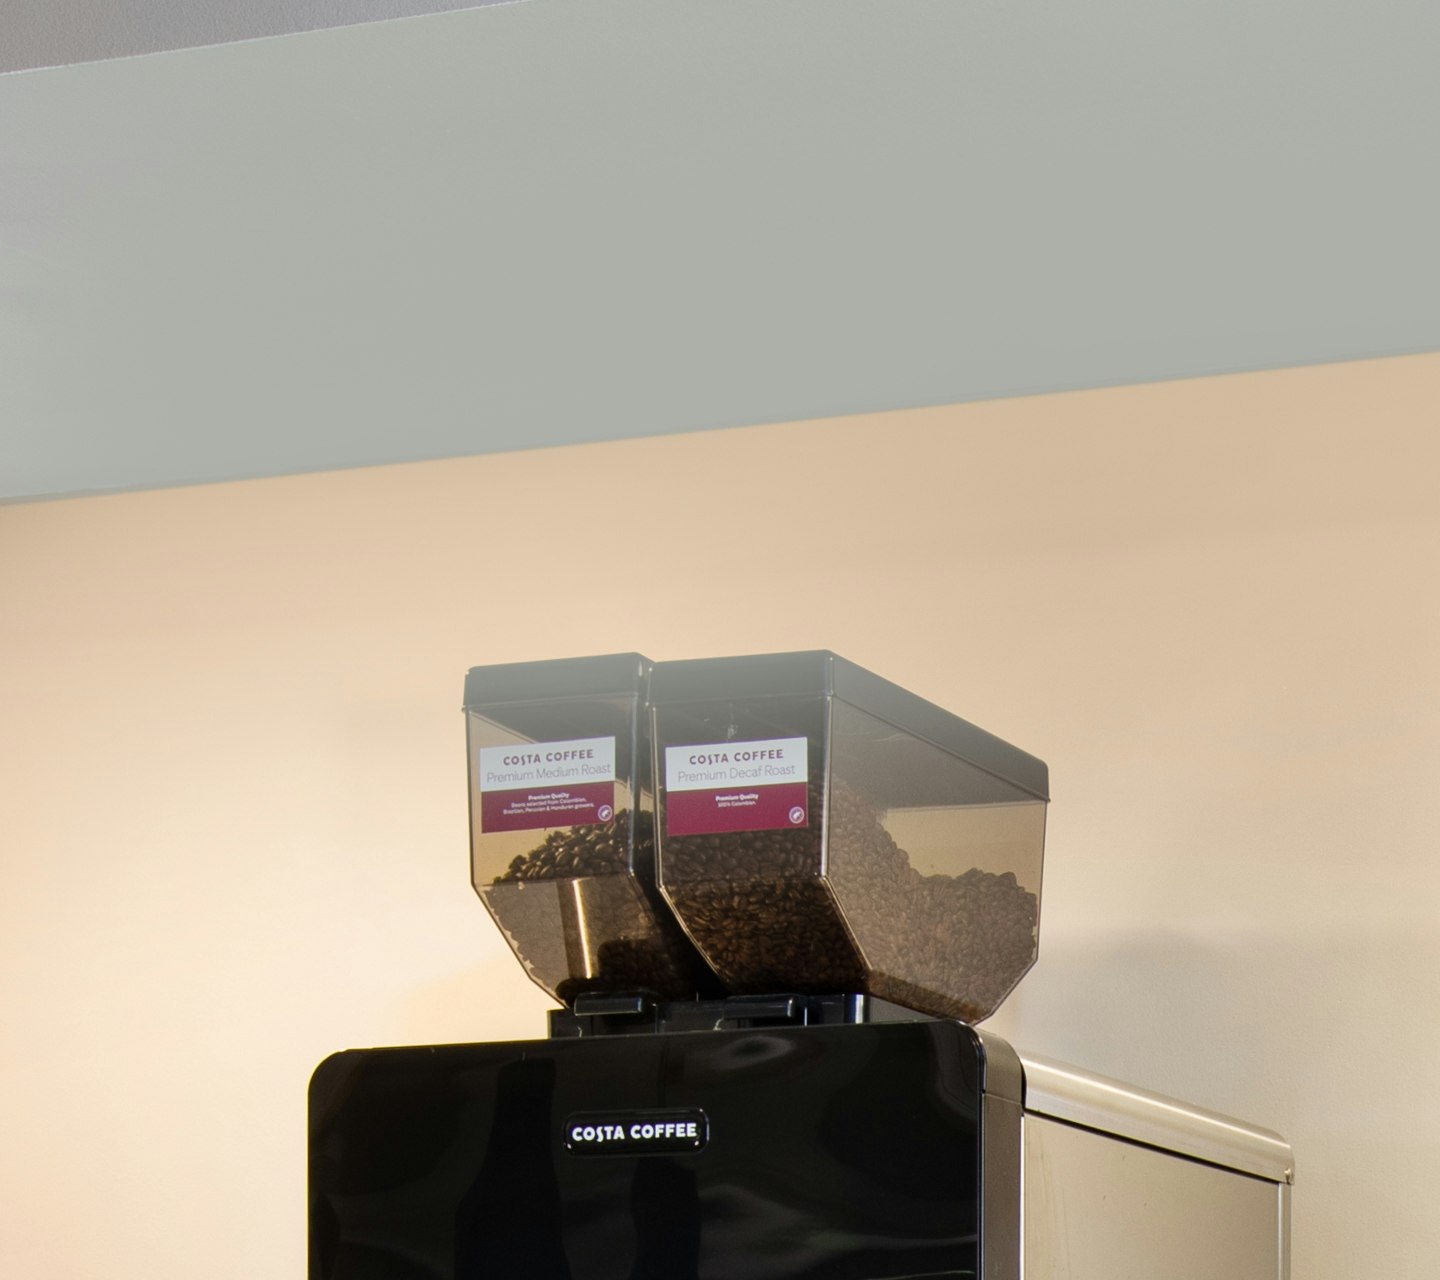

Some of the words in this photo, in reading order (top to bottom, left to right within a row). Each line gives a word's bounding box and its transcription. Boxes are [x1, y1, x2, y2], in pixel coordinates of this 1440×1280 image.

[503, 754, 541, 766] COSTA
[546, 749, 594, 762] COFFEE
[689, 753, 729, 765] COSTA
[734, 749, 784, 762] COFFEE
[486, 771, 533, 783] Premium
[536, 767, 579, 779] Medium
[581, 763, 612, 775] Roast
[678, 770, 727, 783] Premium
[729, 765, 763, 780] Decaf
[764, 764, 796, 776] Roast
[572, 1125, 625, 1142] COSTA
[630, 1123, 697, 1139] COFFEE
